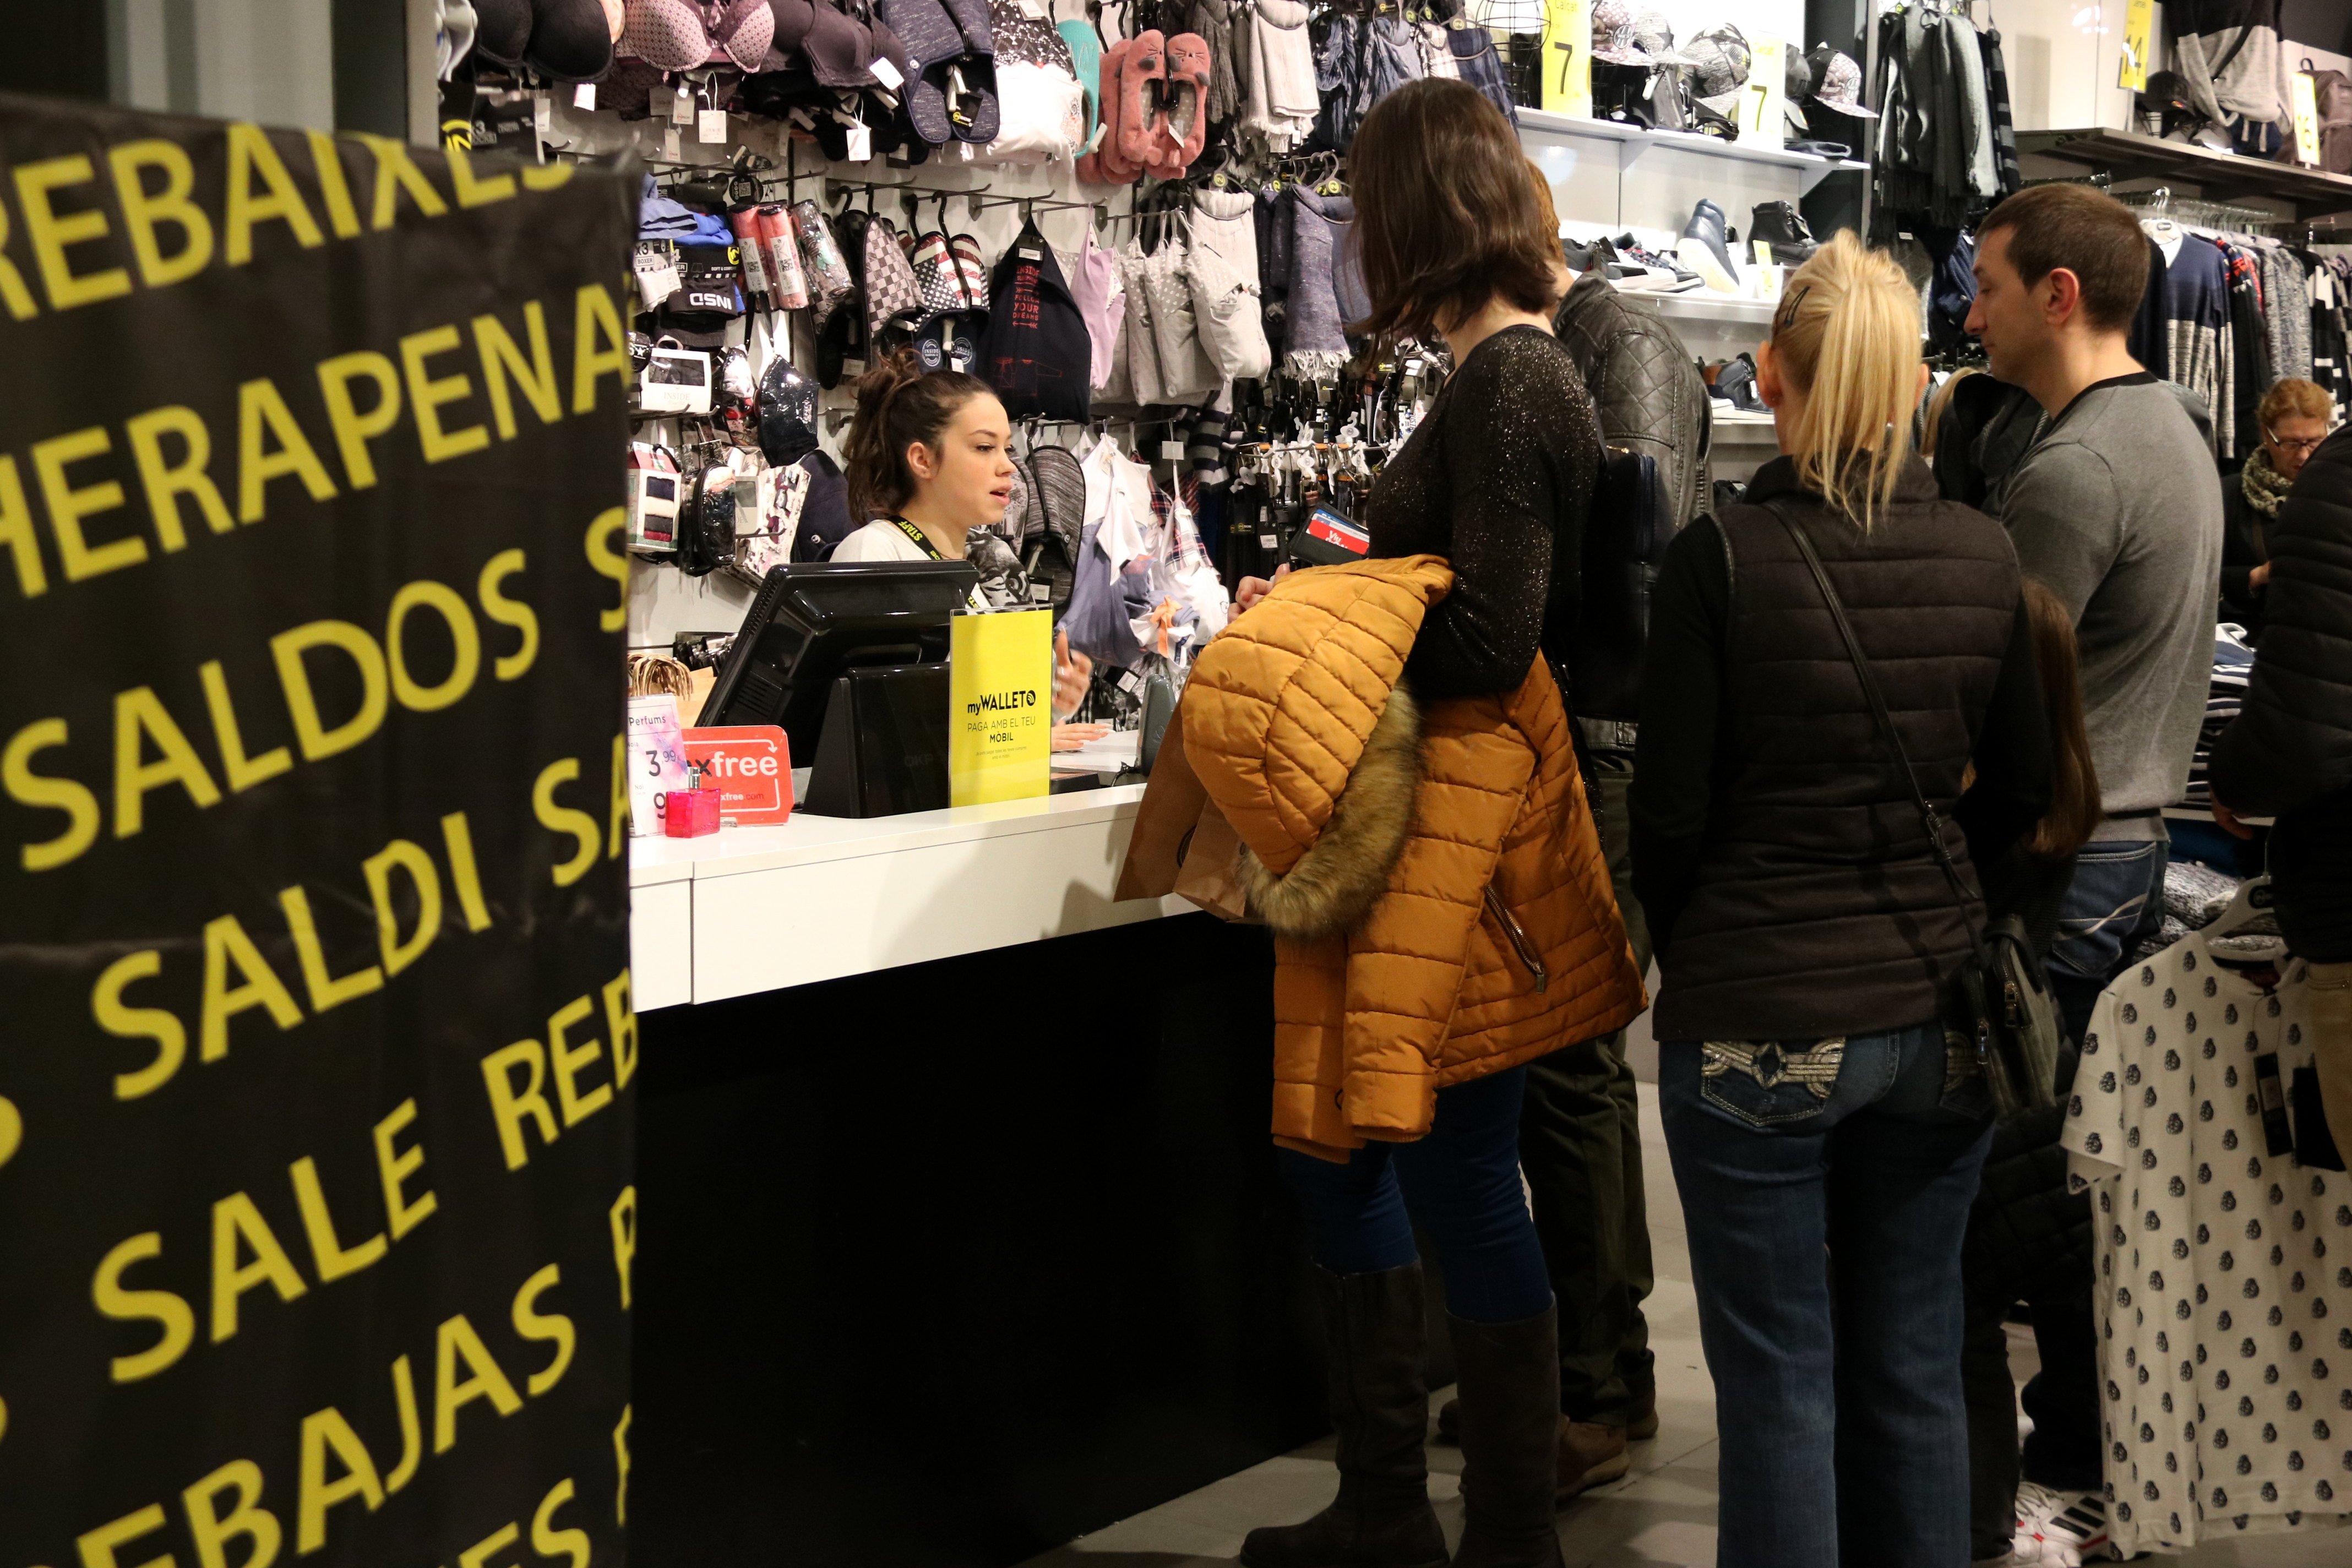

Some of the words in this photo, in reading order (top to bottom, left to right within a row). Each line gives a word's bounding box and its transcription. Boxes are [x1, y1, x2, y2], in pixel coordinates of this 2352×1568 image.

[1554, 41, 1572, 95] 7
[1751, 84, 1767, 132] 7
[0, 123, 573, 321] EBAIX
[1013, 302, 1039, 314] YOUR
[663, 391, 690, 401] INSIDE
[897, 520, 923, 542] STAFF
[2, 549, 540, 871] SALDOS
[629, 715, 666, 726] Perfums
[967, 721, 989, 732] PAGA
[990, 719, 1008, 729] AMB
[1010, 718, 1019, 727] EL
[1021, 716, 1036, 726] TEU
[687, 751, 778, 777] xfree
[720, 792, 764, 801] xfree.com
[92, 812, 492, 1099] SALDI
[92, 1098, 437, 1382] SALE
[22, 1264, 575, 1568] BAJAS
